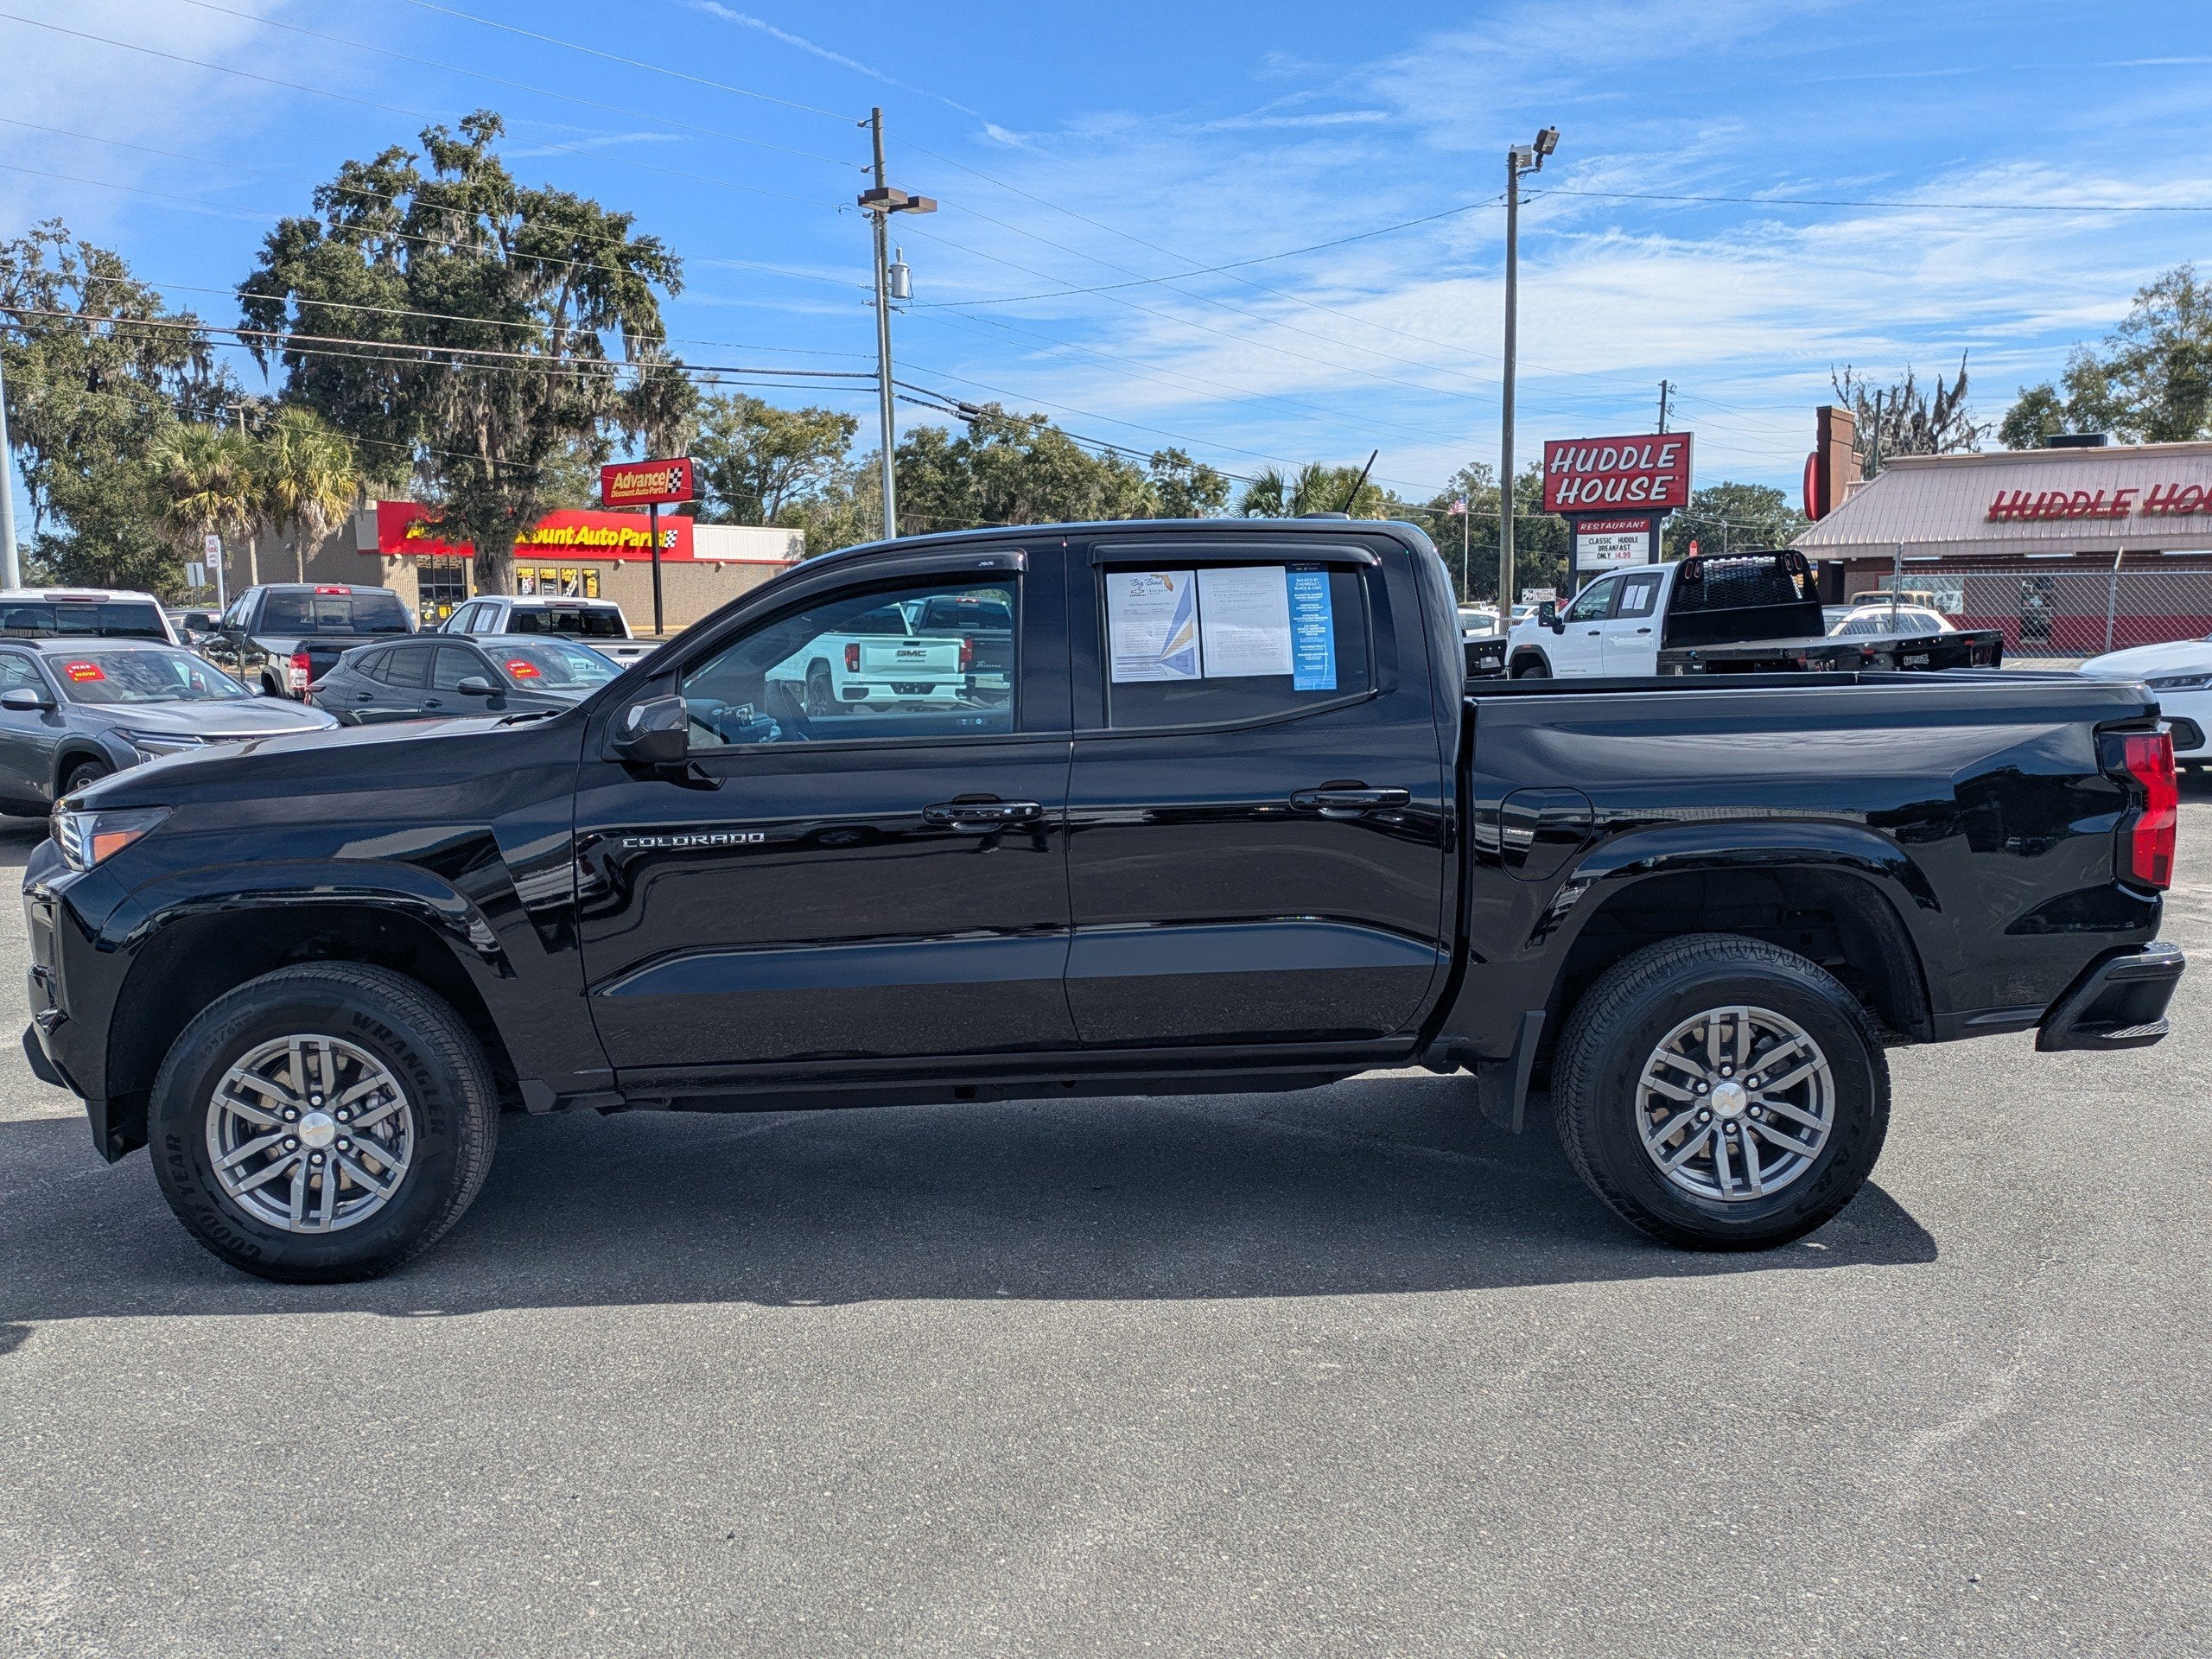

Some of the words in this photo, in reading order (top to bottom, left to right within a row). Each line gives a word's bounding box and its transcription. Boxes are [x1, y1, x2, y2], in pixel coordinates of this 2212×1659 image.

[1550, 442, 1682, 474] HUDDLE
[612, 471, 665, 489] Advance
[1555, 475, 1674, 505] HOUSE
[610, 489, 635, 498] Discount
[635, 487, 649, 496] Auto
[1988, 488, 2139, 522] HUDDLE
[574, 525, 619, 545] Auto
[1580, 521, 1646, 531] RESTAURANT
[622, 832, 765, 848] COLORADO
[350, 1010, 446, 1134] WRANGLER
